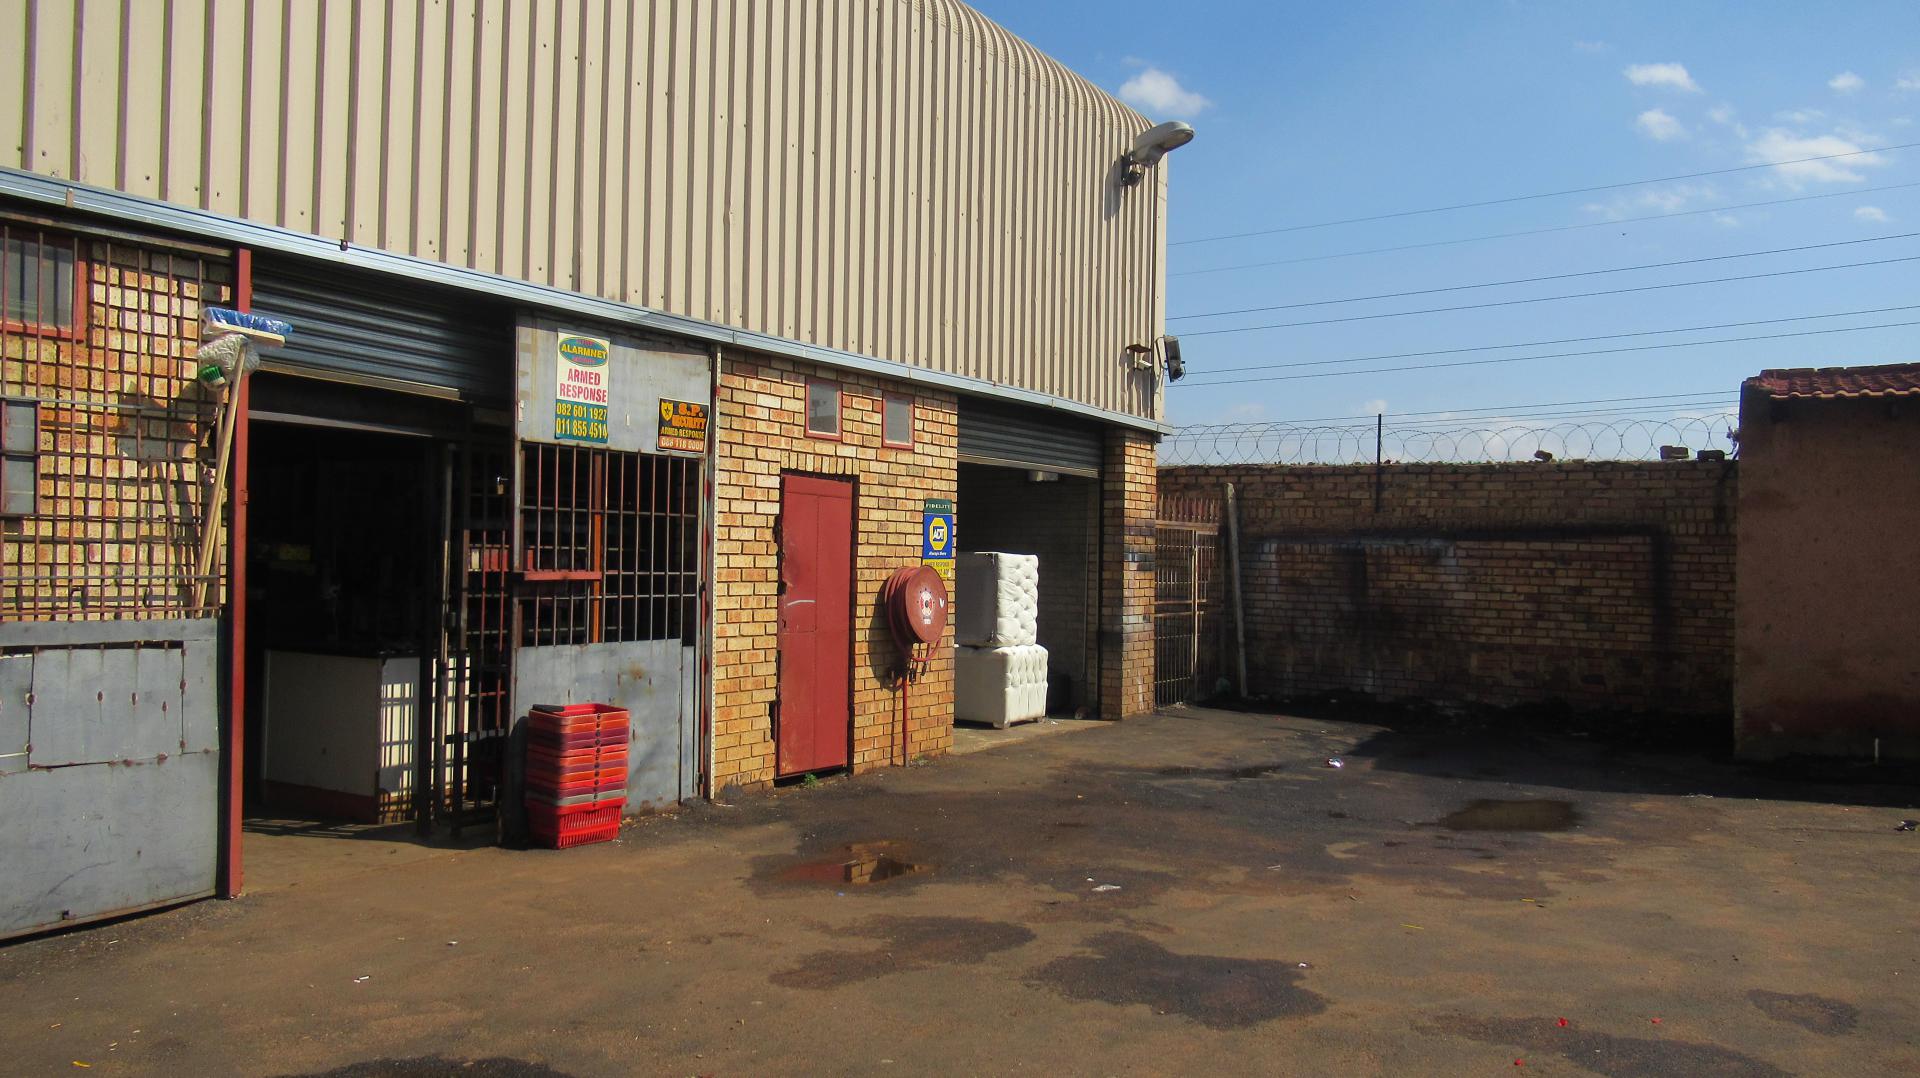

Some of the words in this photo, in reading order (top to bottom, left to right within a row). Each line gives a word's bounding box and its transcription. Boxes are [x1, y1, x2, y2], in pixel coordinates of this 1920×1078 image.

[561, 343, 608, 359] ALARMNET
[568, 368, 601, 386] ARMED
[560, 383, 607, 403] RESPONSE
[557, 403, 571, 416] 082
[573, 405, 587, 418] 601
[589, 407, 607, 421] 1927
[556, 418, 570, 435] 011
[573, 420, 587, 437] 855
[589, 422, 608, 439] 4514
[661, 426, 679, 436] ARMED
[679, 429, 704, 439] RESPONSE
[933, 529, 944, 540] ADT
